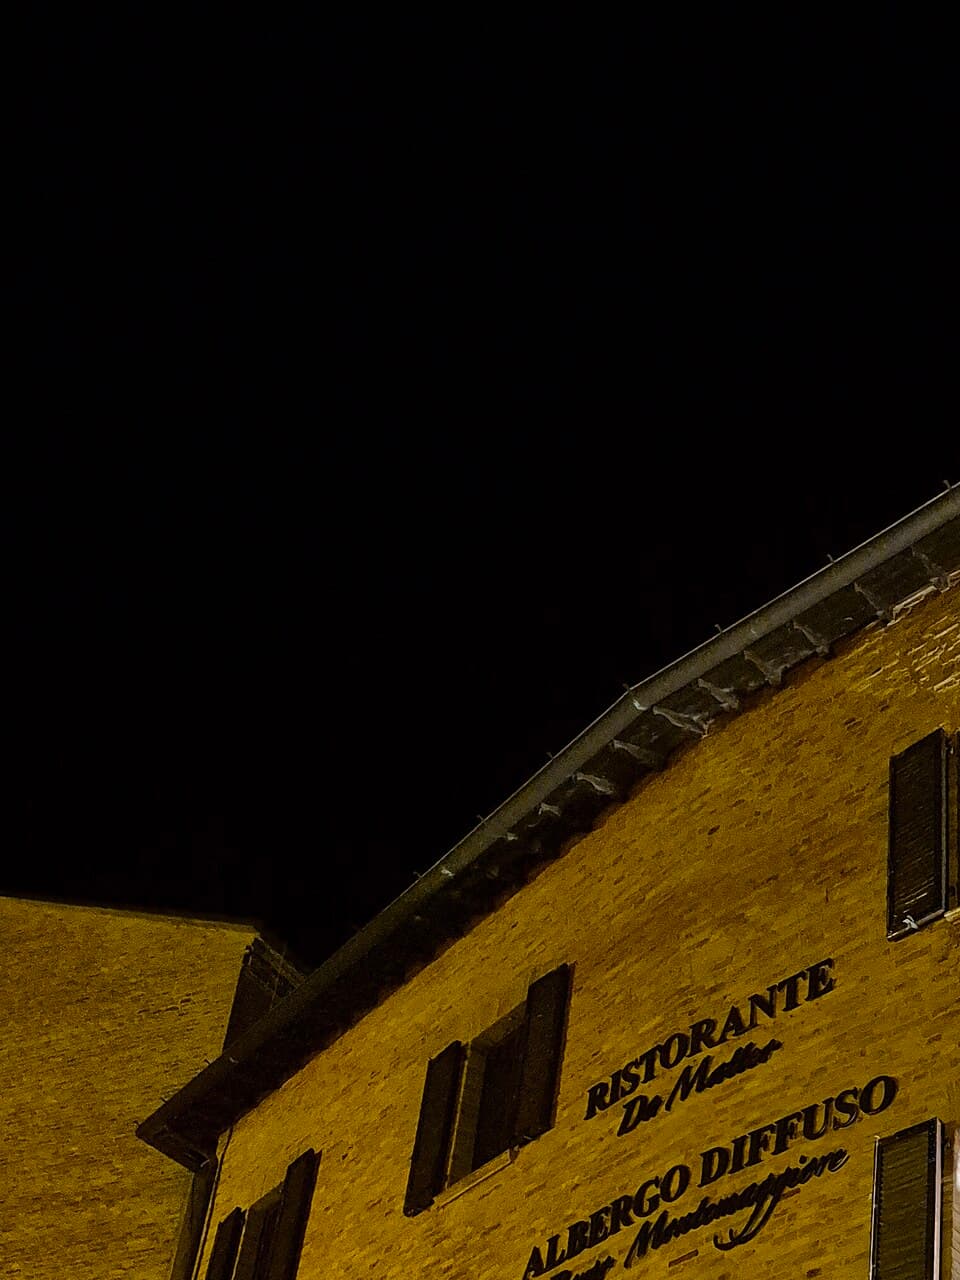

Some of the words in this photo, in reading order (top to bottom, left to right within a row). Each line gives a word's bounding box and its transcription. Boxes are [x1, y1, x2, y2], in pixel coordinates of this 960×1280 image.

[583, 958, 836, 1121] RISTORANTE
[617, 1095, 663, 1136] Da
[697, 1075, 900, 1189] DIFFUSO
